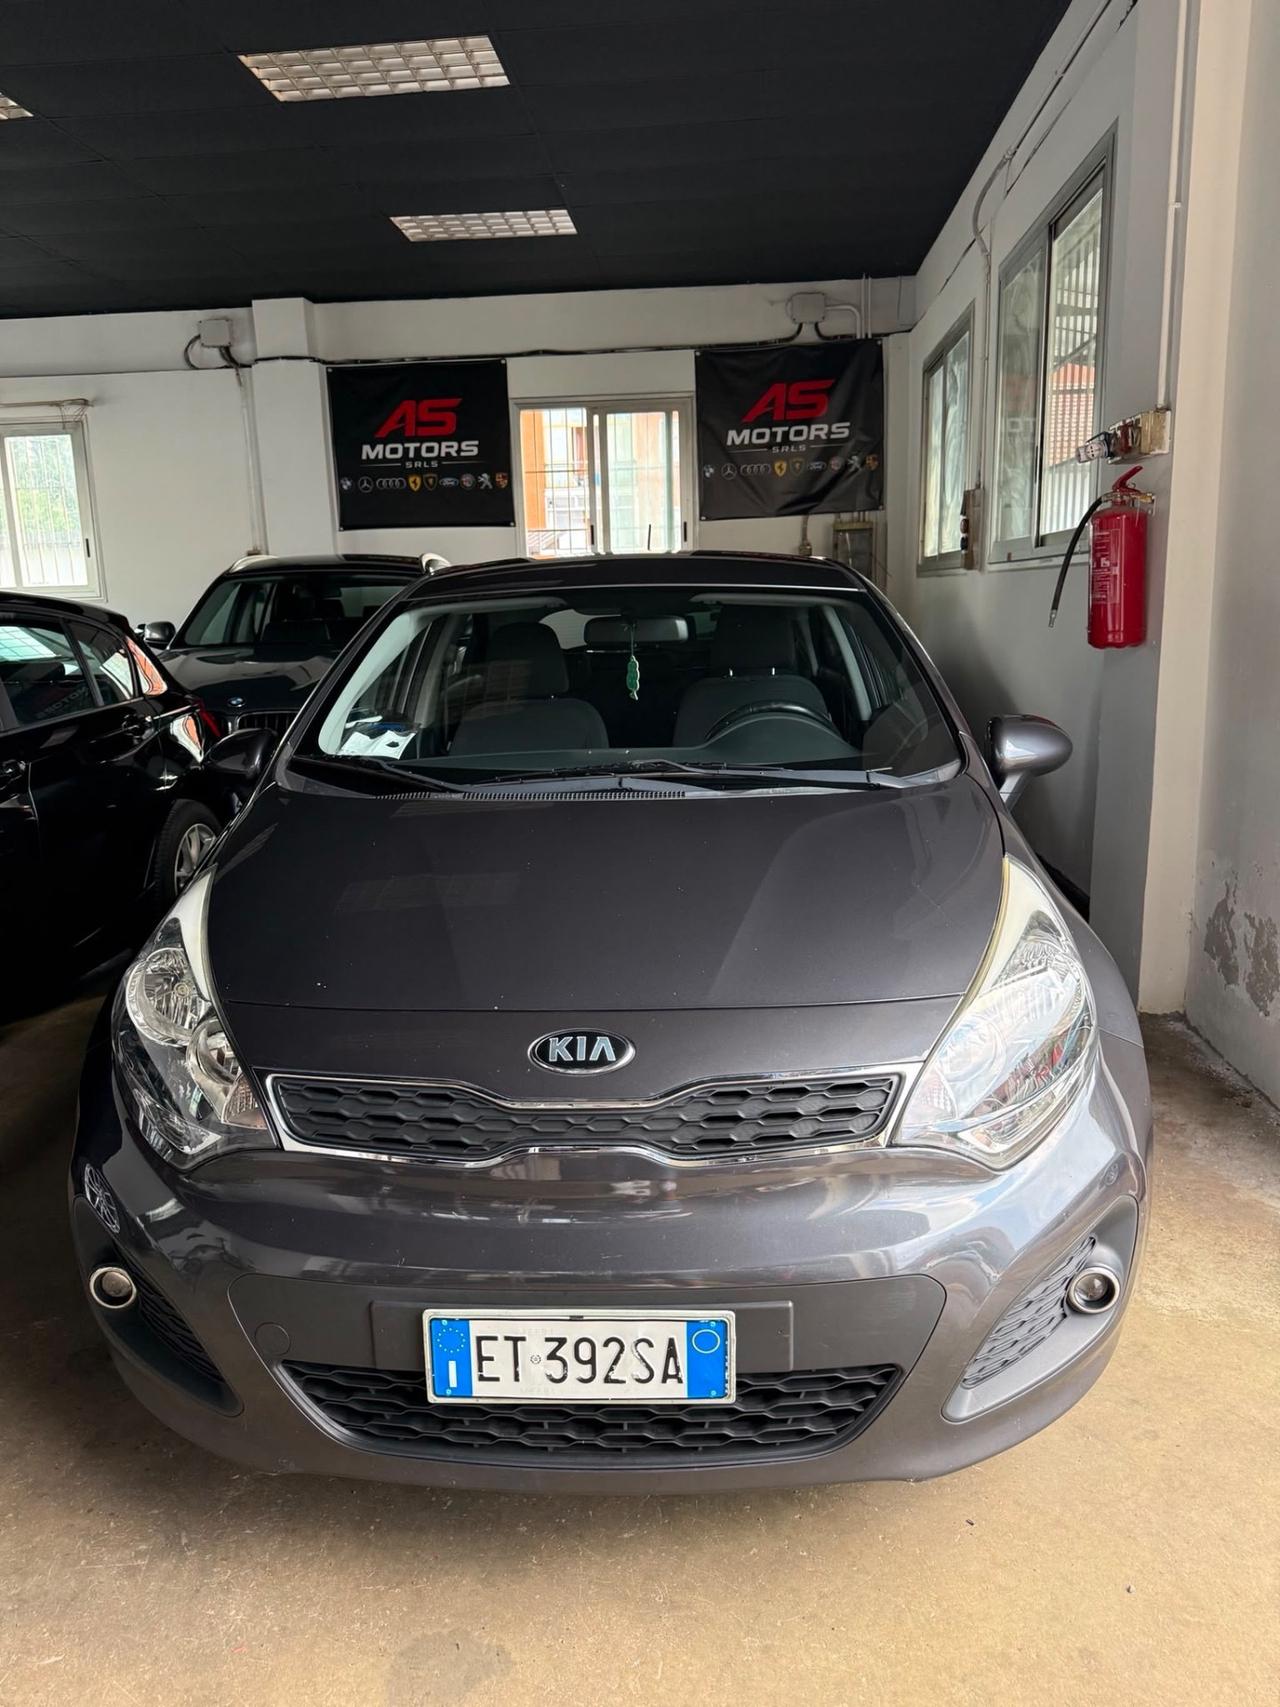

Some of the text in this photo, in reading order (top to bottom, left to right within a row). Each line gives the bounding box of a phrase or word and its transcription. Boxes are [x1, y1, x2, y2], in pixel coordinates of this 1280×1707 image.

[741, 378, 835, 423] AS
[374, 398, 462, 438] AS
[726, 422, 850, 446] MOTORS
[361, 440, 479, 460] MOTORS
[772, 444, 806, 453] SRLS
[405, 460, 438, 468] SRLS
[549, 1036, 616, 1061] KIA
